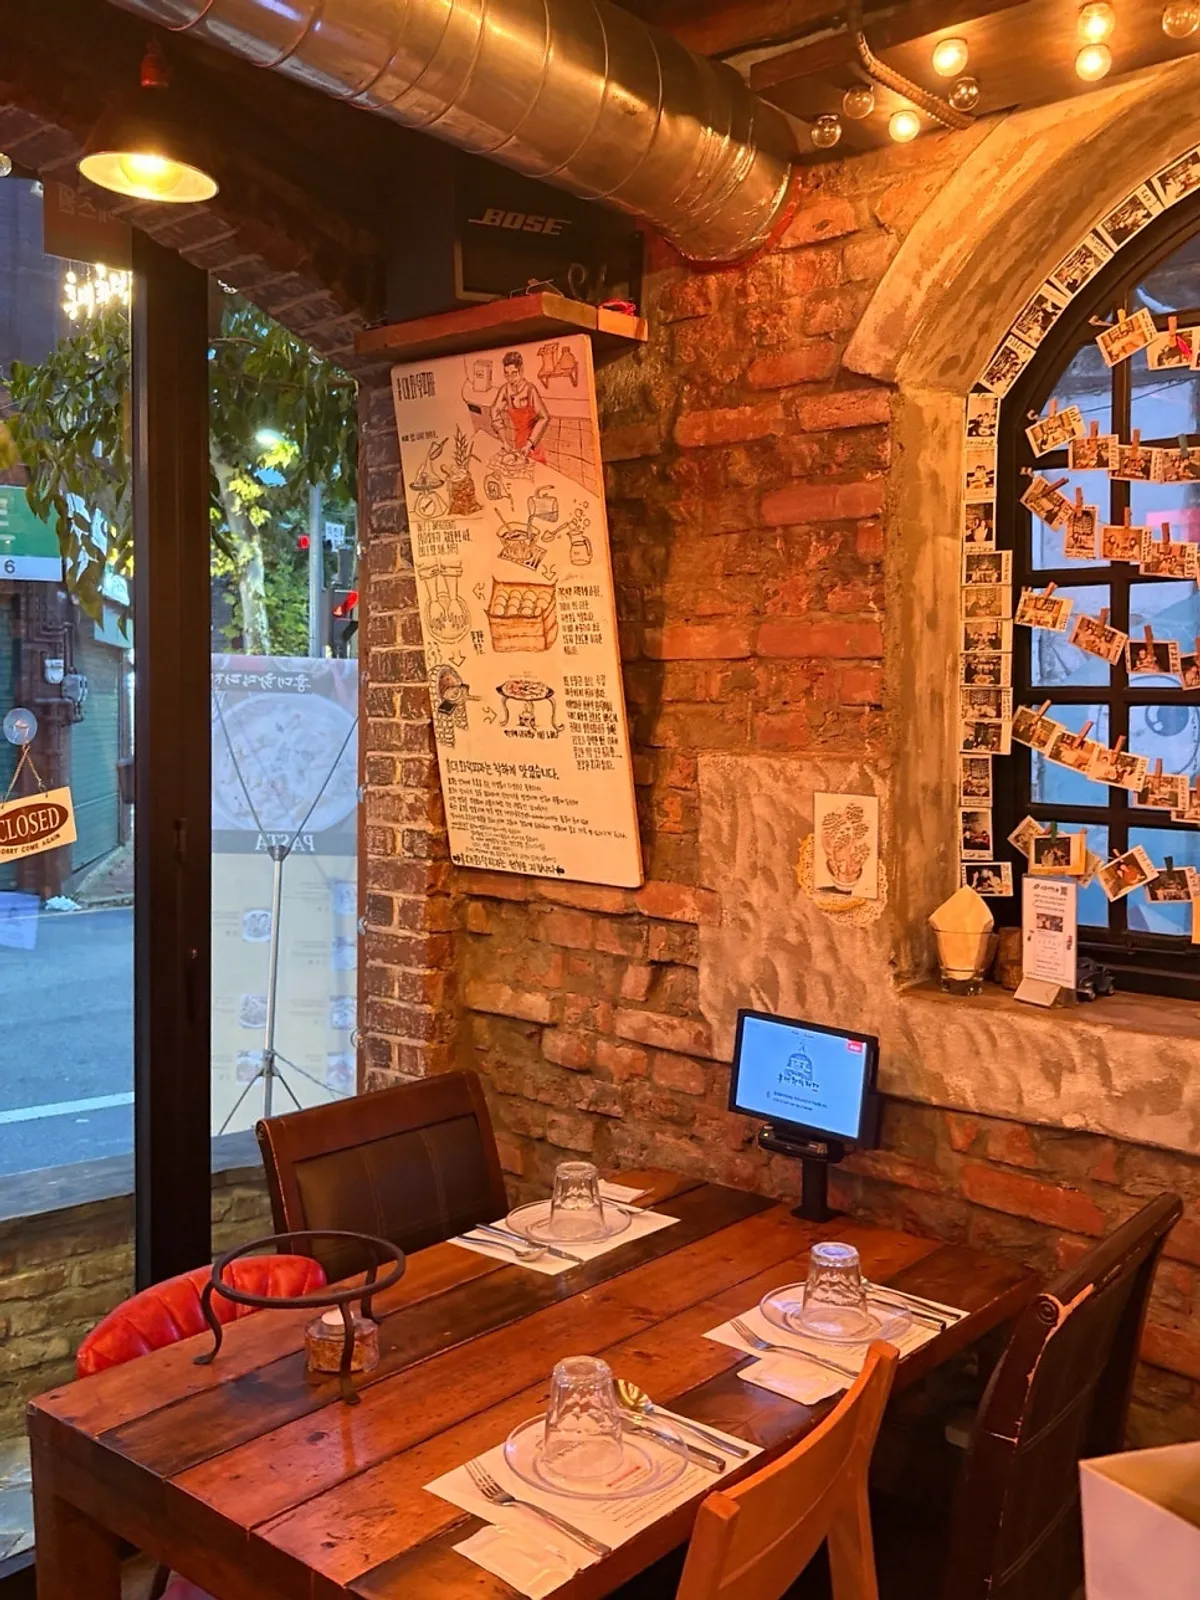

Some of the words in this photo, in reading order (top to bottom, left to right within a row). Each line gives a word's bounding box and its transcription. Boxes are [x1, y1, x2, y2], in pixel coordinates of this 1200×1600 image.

[468, 208, 572, 236] BOSE
[4, 559, 16, 574] 6
[0, 806, 60, 843] CLOSED
[21, 843, 39, 853] COME
[42, 833, 60, 846] AGAIN
